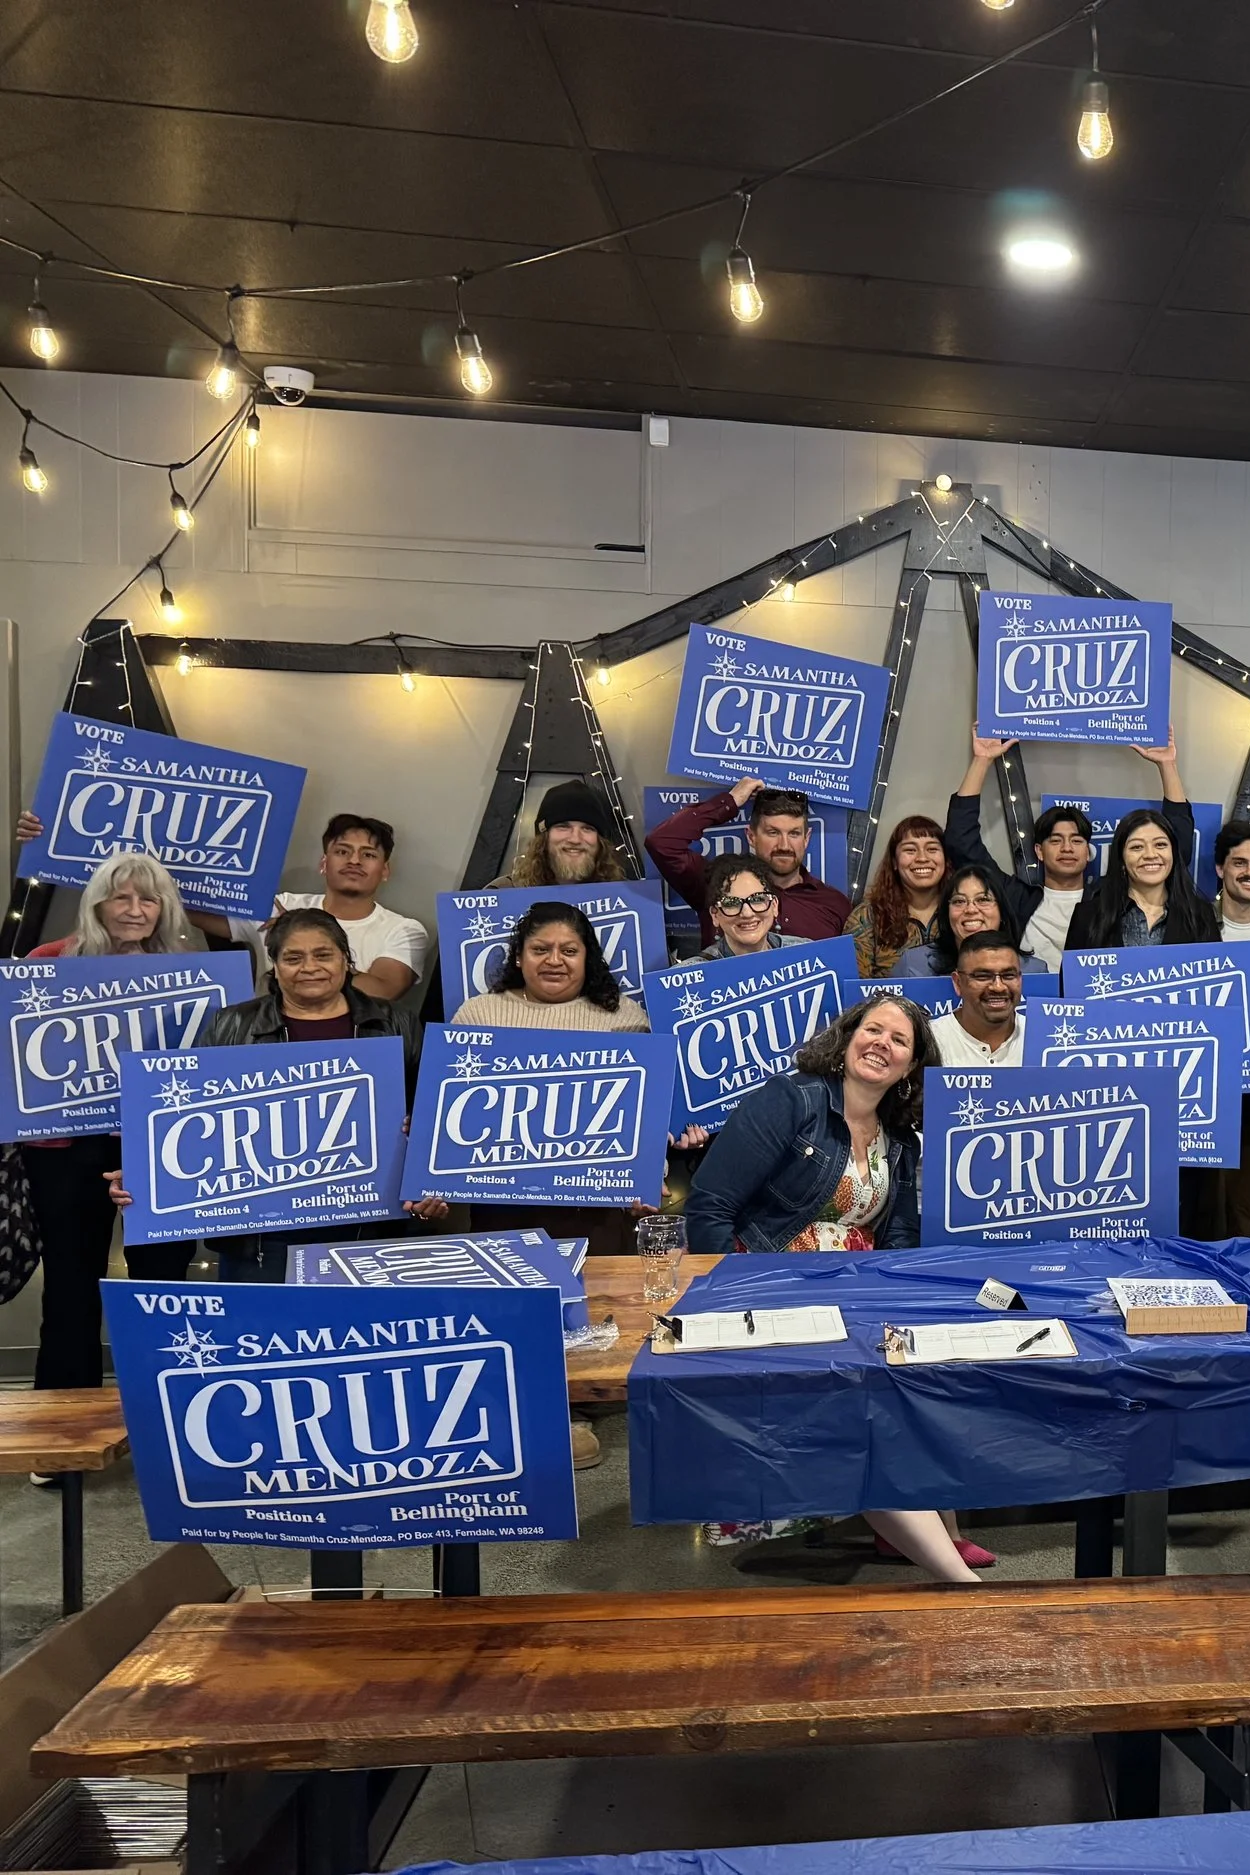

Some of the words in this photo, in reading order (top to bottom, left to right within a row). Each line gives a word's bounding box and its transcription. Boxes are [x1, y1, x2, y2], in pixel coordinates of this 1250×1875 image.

[994, 597, 1031, 610] VOTE
[1033, 615, 1141, 632] SAMANTHA
[707, 632, 746, 651] VOTE
[744, 663, 858, 687] SAMANTHA
[1004, 640, 1138, 693] CRUZ
[1025, 690, 1139, 708] MENDOZA
[705, 686, 852, 744] CRUZ
[1112, 713, 1132, 722] Port
[75, 722, 124, 744] VOTE
[1088, 719, 1147, 732] Bellingham
[724, 738, 845, 761] MENDOZA
[120, 758, 263, 786] SAMANTHA
[720, 760, 752, 772] Position
[815, 769, 835, 780] Port
[788, 771, 849, 791] Bellingham
[659, 792, 699, 803] VOTE
[69, 782, 256, 849] CRUZ
[205, 876, 230, 888] Port
[453, 896, 497, 908] VOTE
[1077, 954, 1117, 966] VOTE
[0, 965, 55, 979] VOTE
[659, 970, 704, 988] VOTE
[1121, 956, 1235, 986] SAMANTHA
[62, 969, 212, 1002] SAMANTHA
[711, 957, 825, 1004] SAMANTHA
[1042, 1004, 1084, 1016] VOTE
[26, 997, 213, 1079] CRUZ
[444, 1031, 492, 1045] VOTE
[688, 983, 830, 1078] CRUZ
[1085, 1020, 1208, 1040] SAMANTHA
[141, 1056, 197, 1071] VOTE
[492, 1049, 635, 1071] SAMANTHA
[203, 1057, 360, 1095] SAMANTHA
[942, 1074, 991, 1088] VOTE
[995, 1085, 1138, 1116] SAMANTHA
[446, 1078, 629, 1145] CRUZ
[161, 1087, 356, 1178] CRUZ
[470, 1139, 625, 1163] MENDOZA
[956, 1117, 1134, 1199] CRUZ
[196, 1152, 364, 1197] MENDOZA
[466, 1175, 506, 1184] Position
[509, 1176, 514, 1184] 4
[587, 1168, 613, 1178] Port
[617, 1169, 631, 1177] of
[327, 1184, 355, 1194] Port
[359, 1182, 374, 1191] of
[554, 1175, 633, 1190] Bellingham
[292, 1192, 378, 1208] Bellingham
[985, 1185, 1137, 1218] MENDOZA
[195, 1206, 240, 1217] Position
[1102, 1218, 1128, 1228] Port
[1132, 1218, 1146, 1226] of
[519, 1232, 543, 1246] VOTE
[983, 1231, 1023, 1239] Position
[1025, 1231, 1031, 1239] 4
[1070, 1228, 1149, 1242] Bellingham
[134, 1294, 226, 1316] VOTE
[982, 1286, 1008, 1308] Reserved
[237, 1314, 492, 1358] SAMANTHA
[184, 1359, 489, 1469] CRUZ
[244, 1449, 504, 1495] MENDOZA
[444, 1492, 492, 1505] Port
[496, 1490, 520, 1504] of
[246, 1508, 313, 1523] Position
[315, 1512, 326, 1524] 4
[391, 1502, 528, 1522] Bellingham
[181, 1527, 202, 1537] Paid
[204, 1529, 218, 1538] for
[219, 1530, 230, 1540] by
[232, 1530, 264, 1543] People
[264, 1532, 278, 1542] for
[280, 1532, 325, 1544] Samantha
[398, 1532, 412, 1542] PO
[415, 1530, 433, 1540] Box
[435, 1529, 454, 1540] 413,
[499, 1527, 516, 1536] WA
[517, 1526, 544, 1536] 98248
